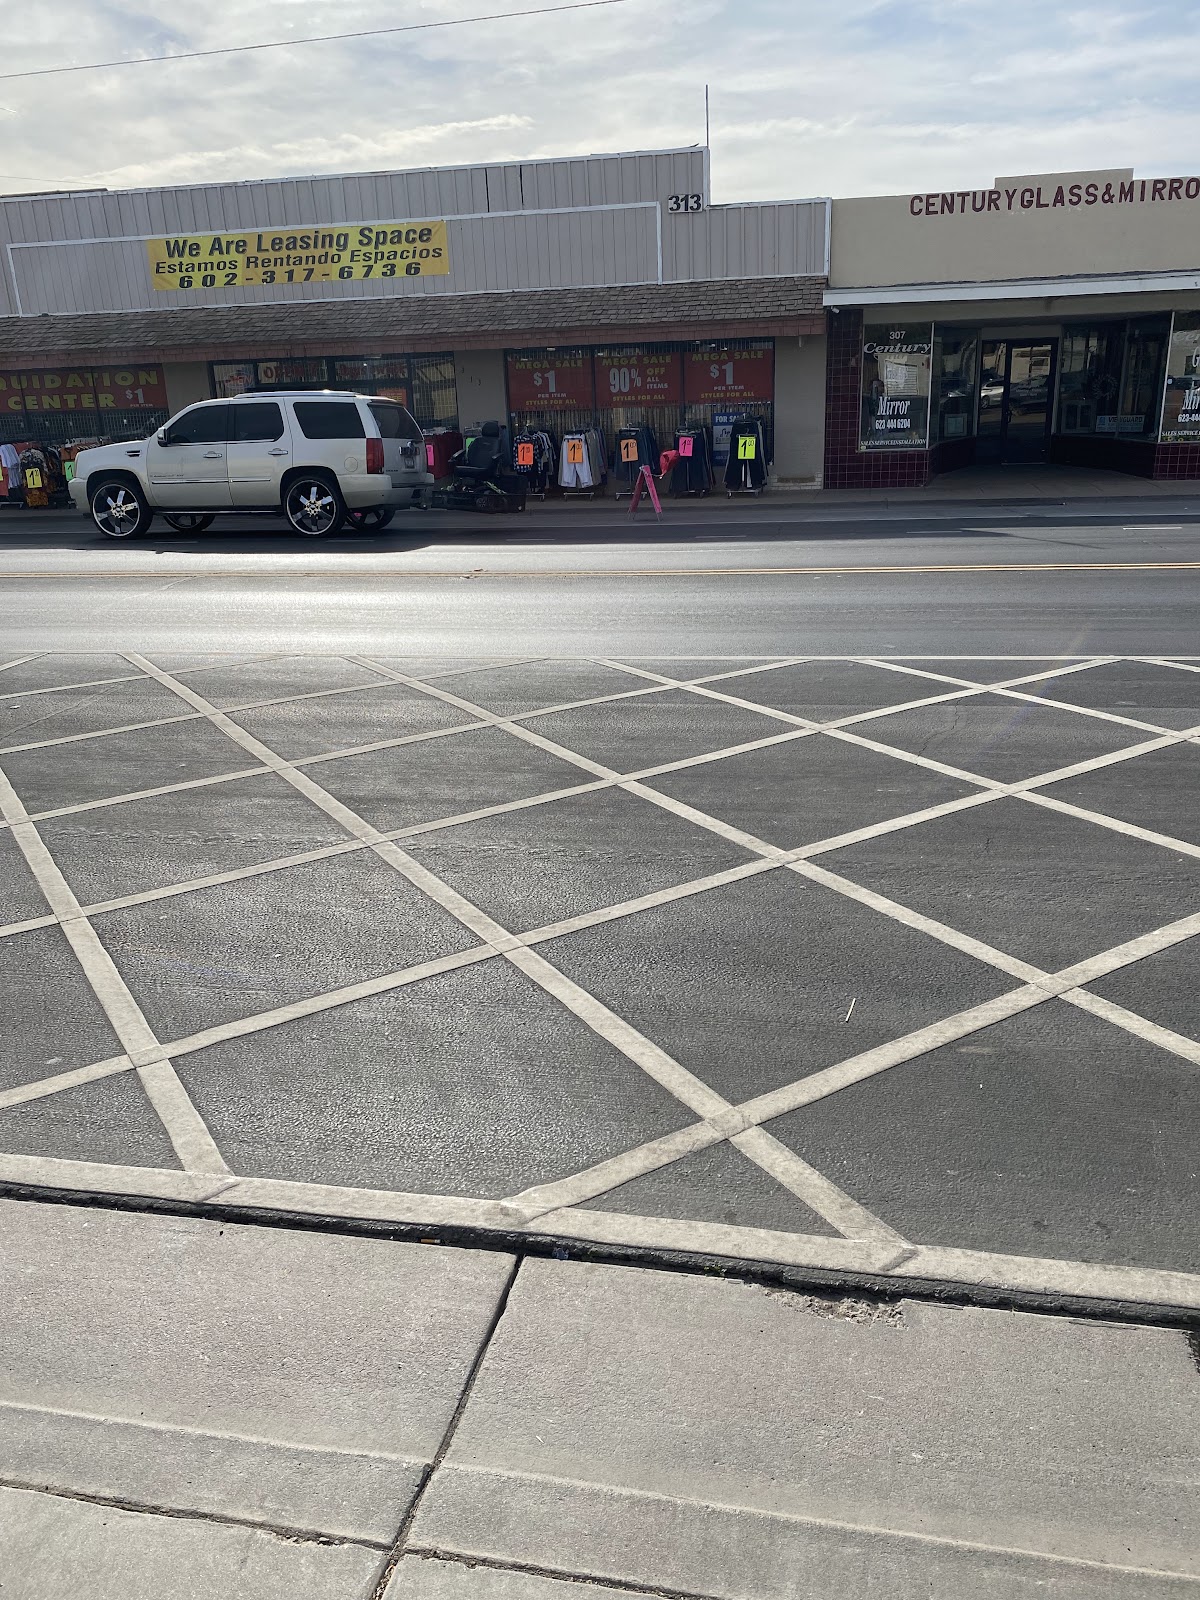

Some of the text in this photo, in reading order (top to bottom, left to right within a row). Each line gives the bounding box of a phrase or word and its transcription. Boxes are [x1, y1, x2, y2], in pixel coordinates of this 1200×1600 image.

[668, 194, 702, 212] 313
[165, 226, 433, 259] We Are Leasing Space
[155, 246, 443, 275] Estamos Rentando Espacios
[178, 262, 421, 289] 602-317-6736
[889, 331, 906, 340] 307
[693, 350, 764, 361] MEGA SALE
[863, 342, 931, 353] Century
[515, 359, 583, 370] MEGA SALE
[602, 355, 672, 366] MEGA SALE
[533, 370, 556, 393] $1
[609, 367, 665, 393] 90% OFF
[710, 362, 734, 385] $1
[8, 394, 117, 411] CENTER
[125, 388, 144, 404] $1
[877, 396, 911, 415] Mirror
